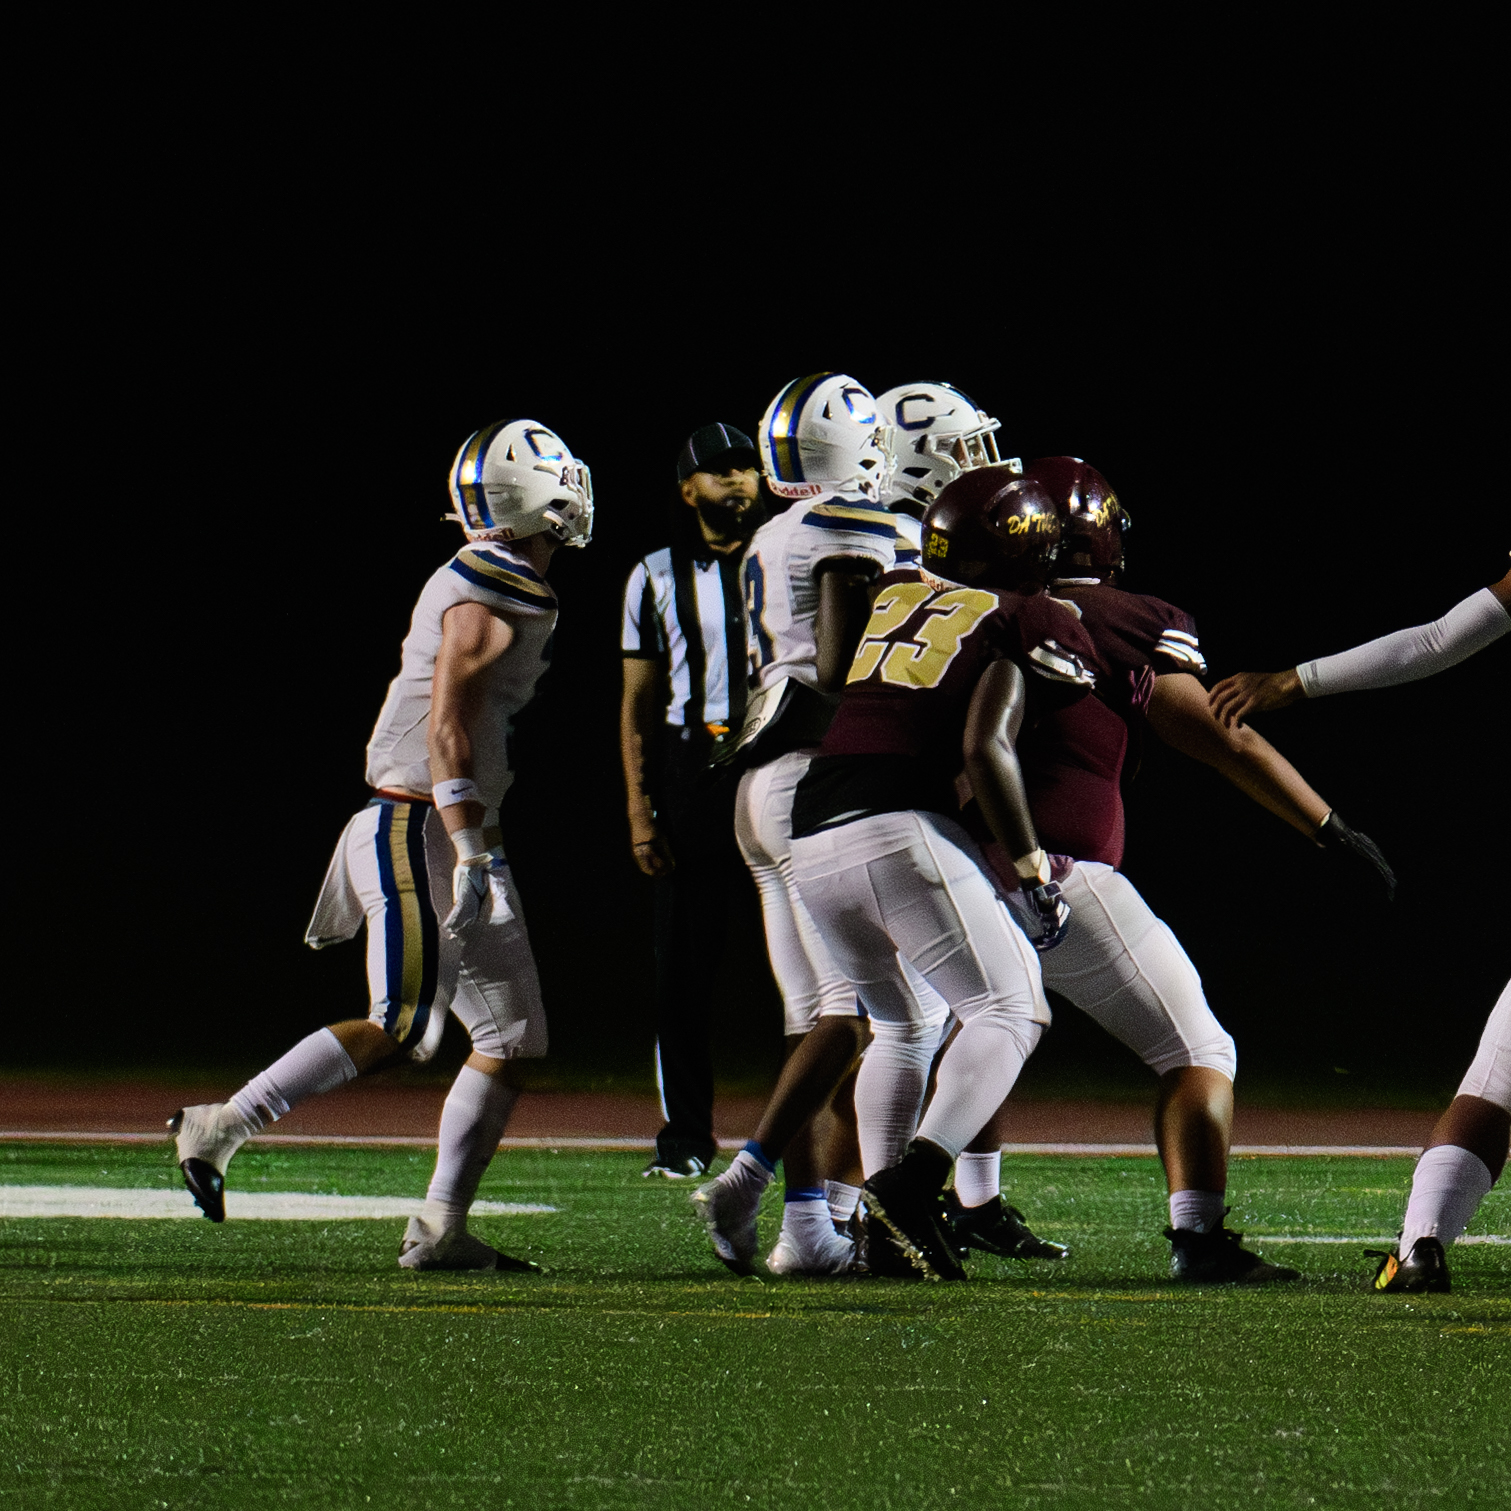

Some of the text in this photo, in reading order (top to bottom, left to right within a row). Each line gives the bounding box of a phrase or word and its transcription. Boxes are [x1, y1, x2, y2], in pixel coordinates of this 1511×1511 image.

[840, 387, 876, 425] C
[896, 393, 936, 431] C
[523, 428, 564, 462] C
[842, 581, 1000, 690] 23
